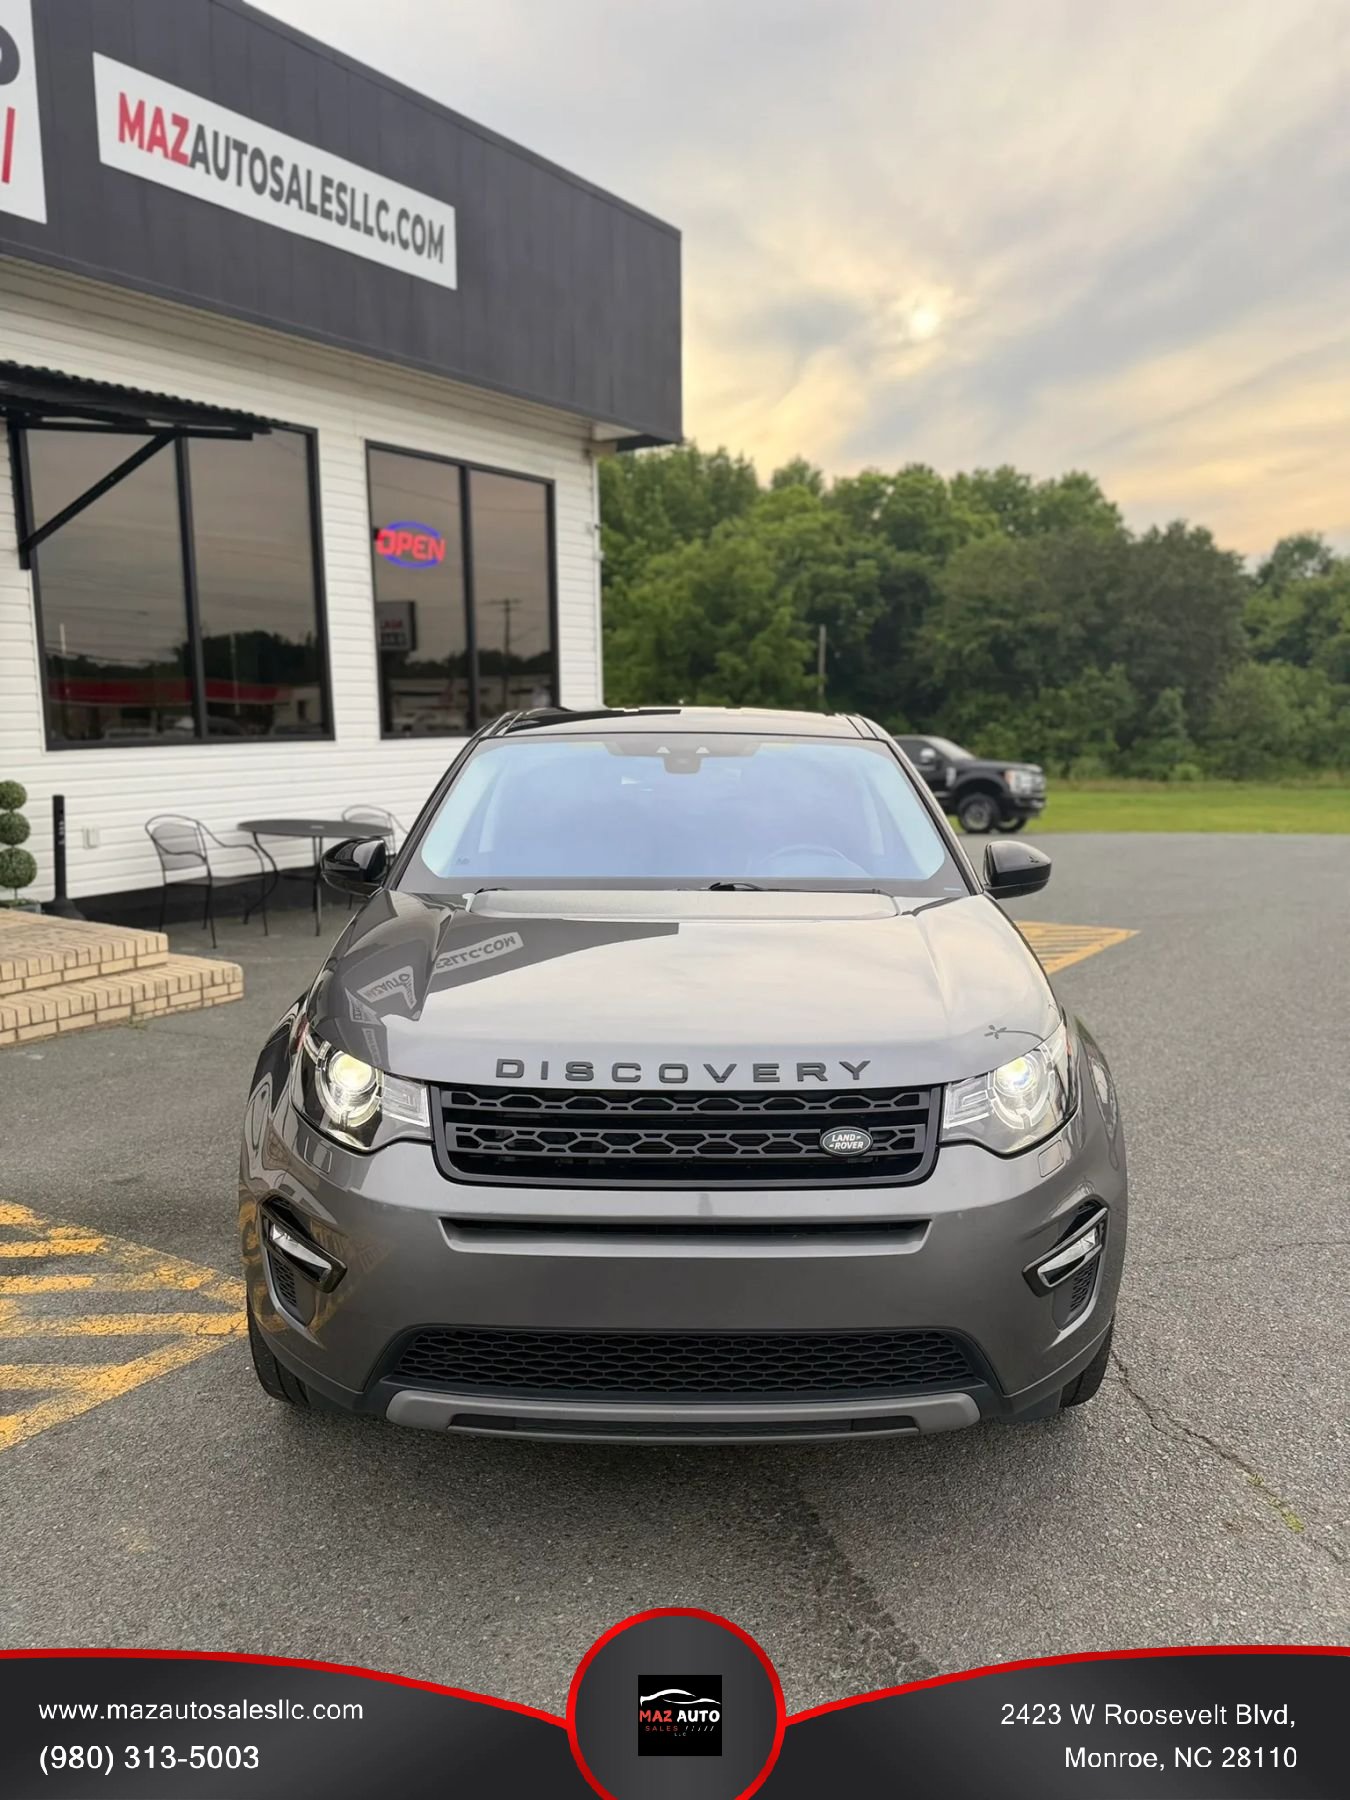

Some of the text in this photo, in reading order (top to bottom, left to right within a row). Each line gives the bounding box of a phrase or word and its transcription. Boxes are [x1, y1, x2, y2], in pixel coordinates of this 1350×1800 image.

[118, 92, 445, 264] MAZAUTOSALESLLC.COM
[375, 528, 447, 562] OPEN
[495, 1058, 871, 1083] DISCOVERY
[831, 1133, 856, 1142] LAND
[834, 1141, 864, 1150] ROVER
